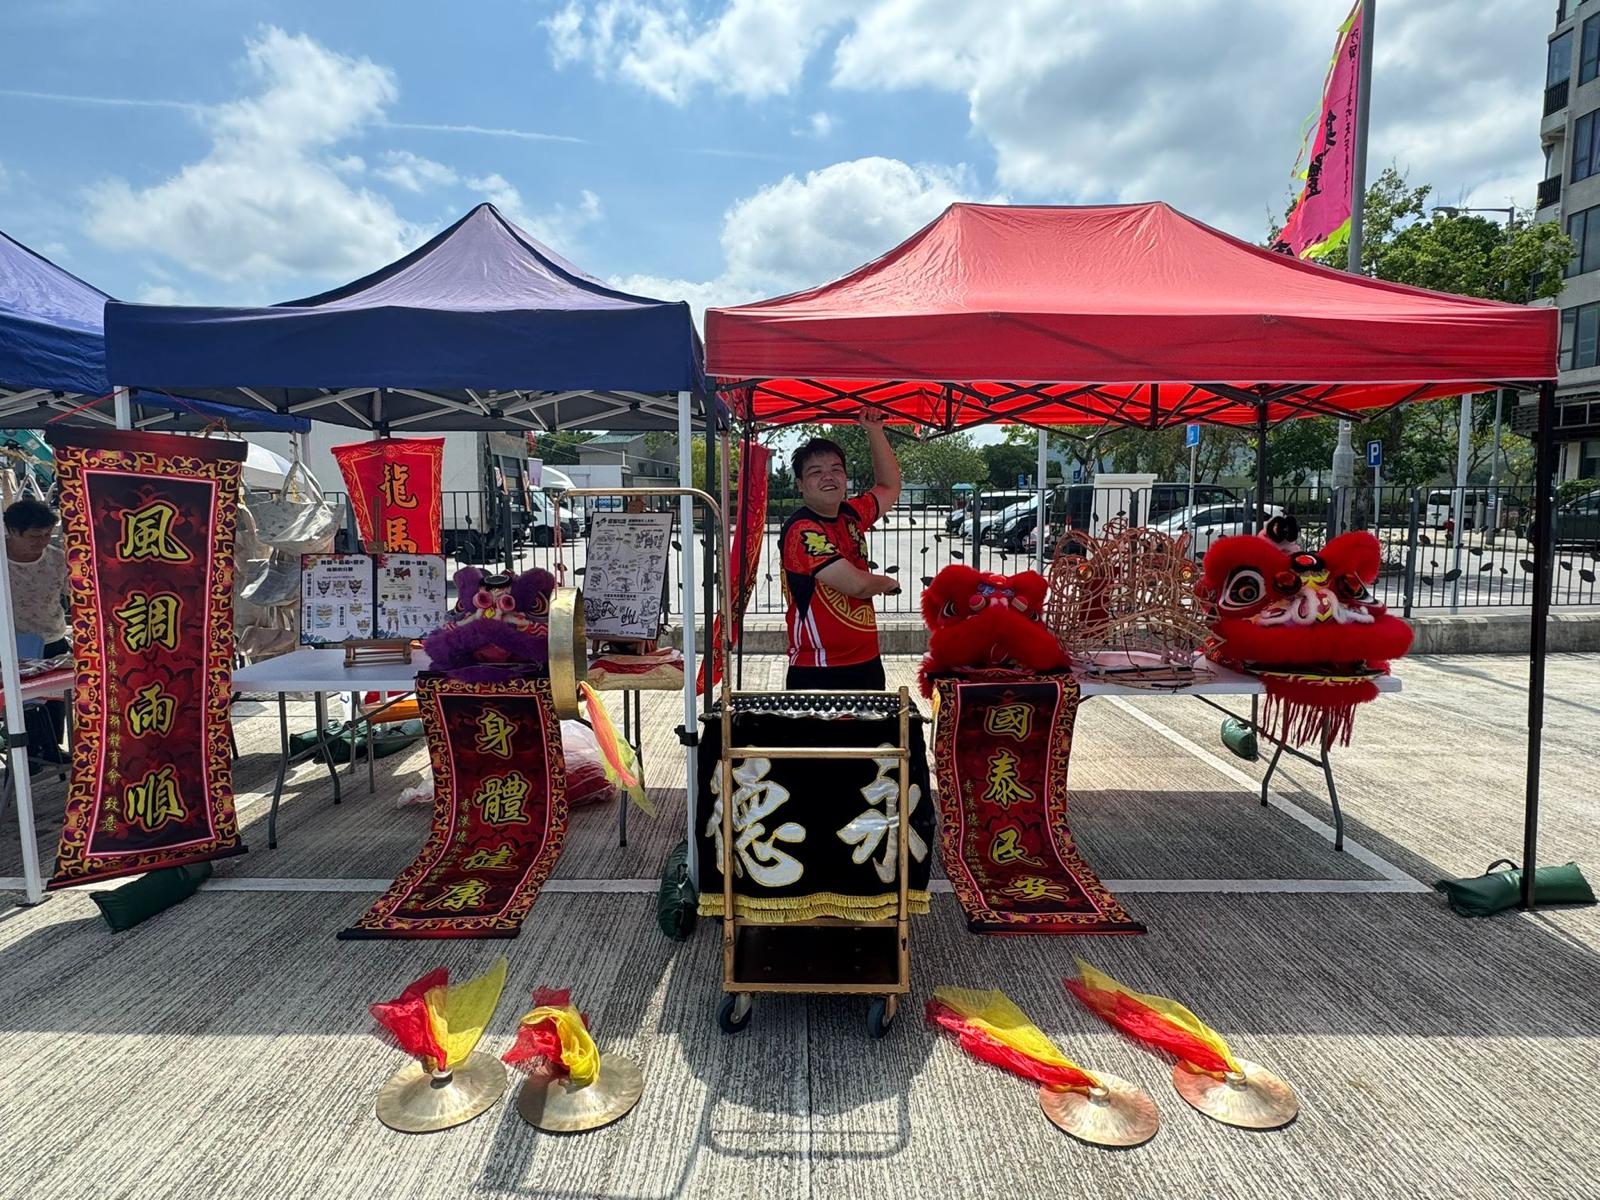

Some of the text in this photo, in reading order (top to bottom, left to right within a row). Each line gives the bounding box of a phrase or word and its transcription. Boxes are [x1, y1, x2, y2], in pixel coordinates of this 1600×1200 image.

[1370, 443, 1379, 464] P
[115, 502, 190, 829] 風調雨順
[425, 711, 529, 908] 身體健康
[985, 704, 1065, 899] 國泰民安
